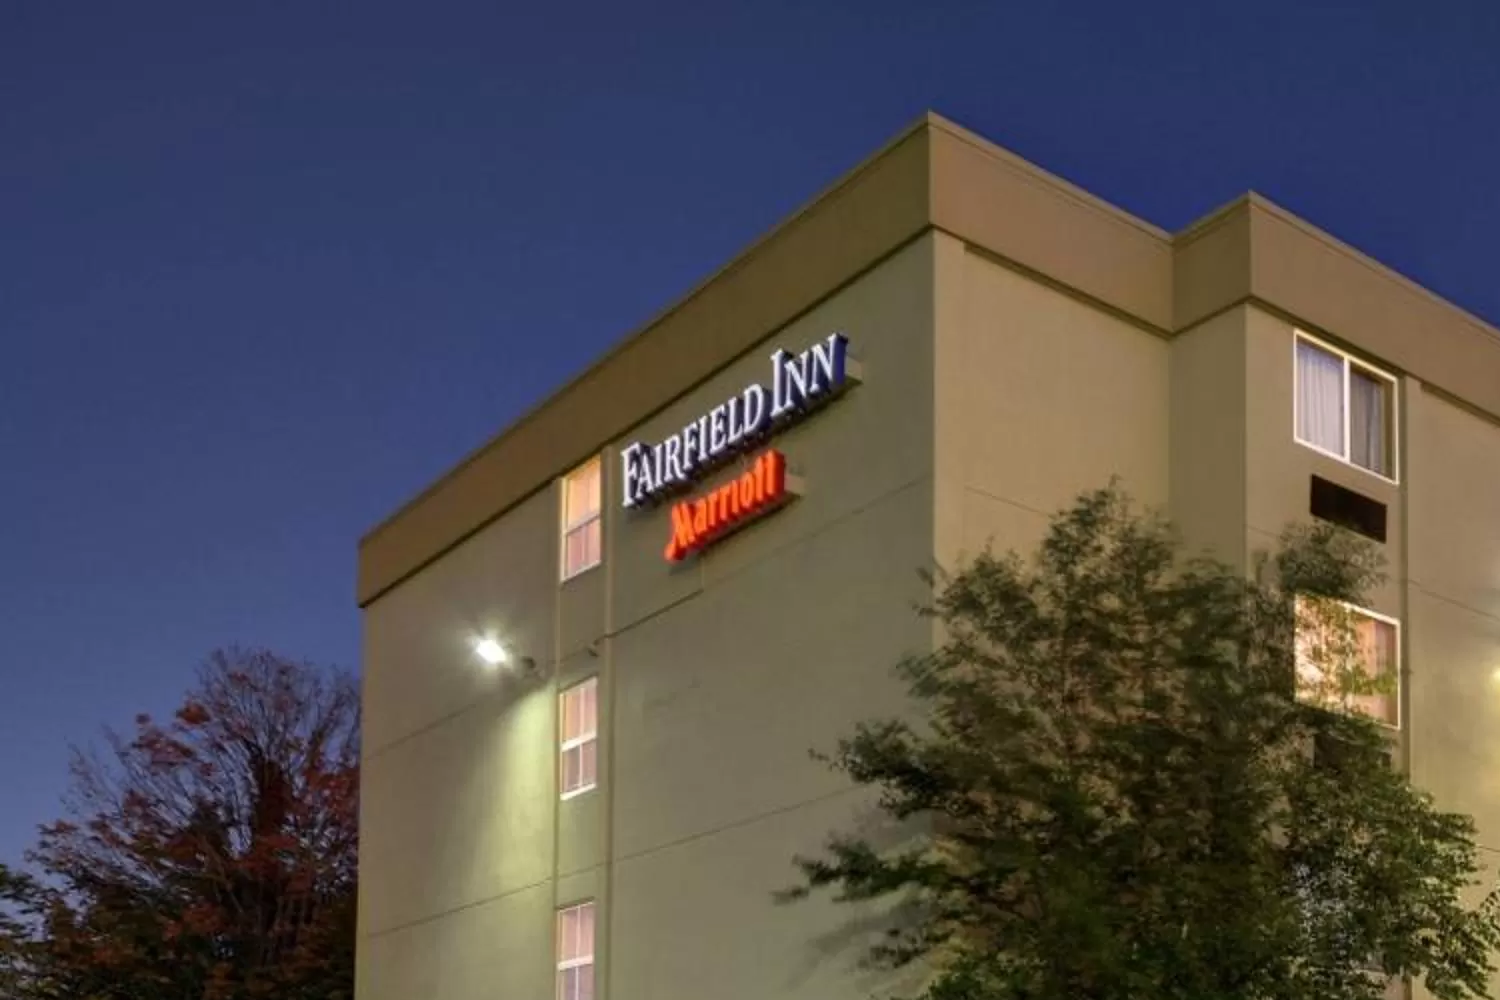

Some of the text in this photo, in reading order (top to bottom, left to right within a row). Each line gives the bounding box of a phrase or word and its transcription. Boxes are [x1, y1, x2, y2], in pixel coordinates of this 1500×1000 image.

[621, 332, 842, 506] FAIRFIELD INN
[663, 448, 783, 562] Marriott
